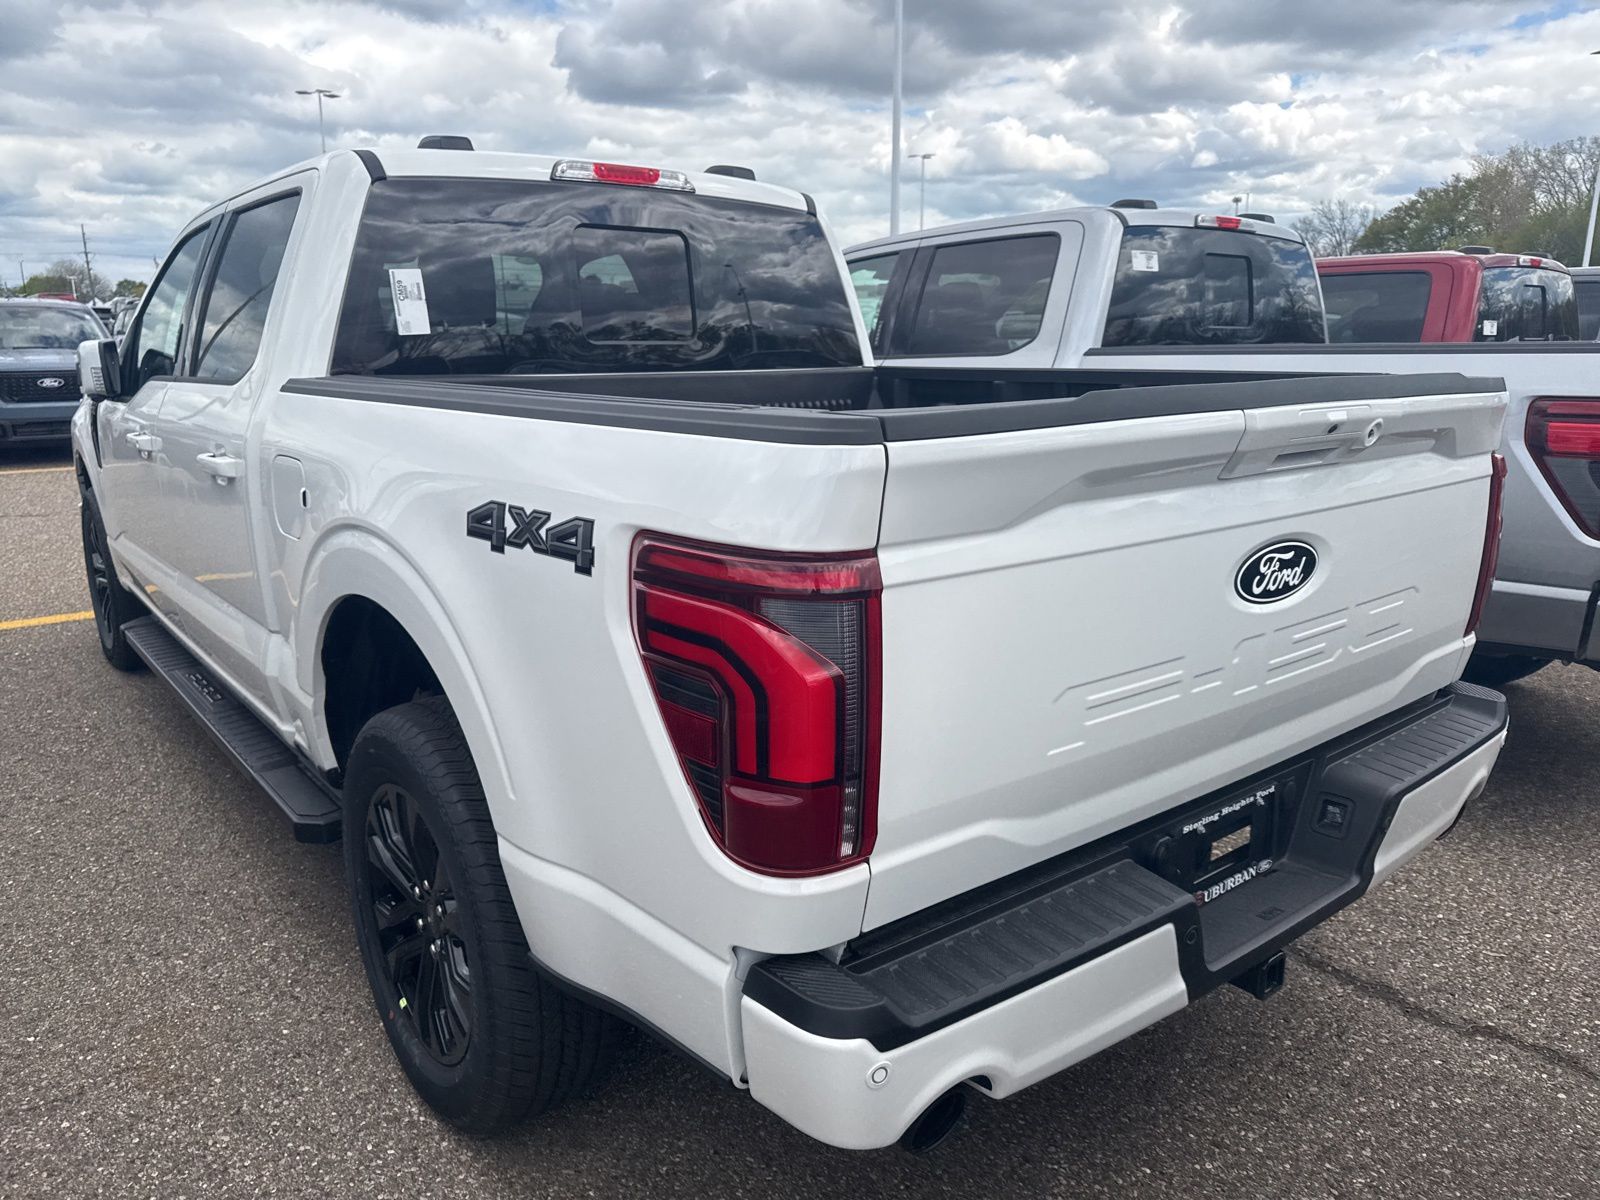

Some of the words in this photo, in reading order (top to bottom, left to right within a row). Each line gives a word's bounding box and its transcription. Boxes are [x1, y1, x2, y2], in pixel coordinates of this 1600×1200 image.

[1252, 551, 1306, 594] Ford
[1182, 812, 1220, 834] Sterling
[1221, 796, 1255, 816] Heights
[1256, 785, 1275, 801] Ford
